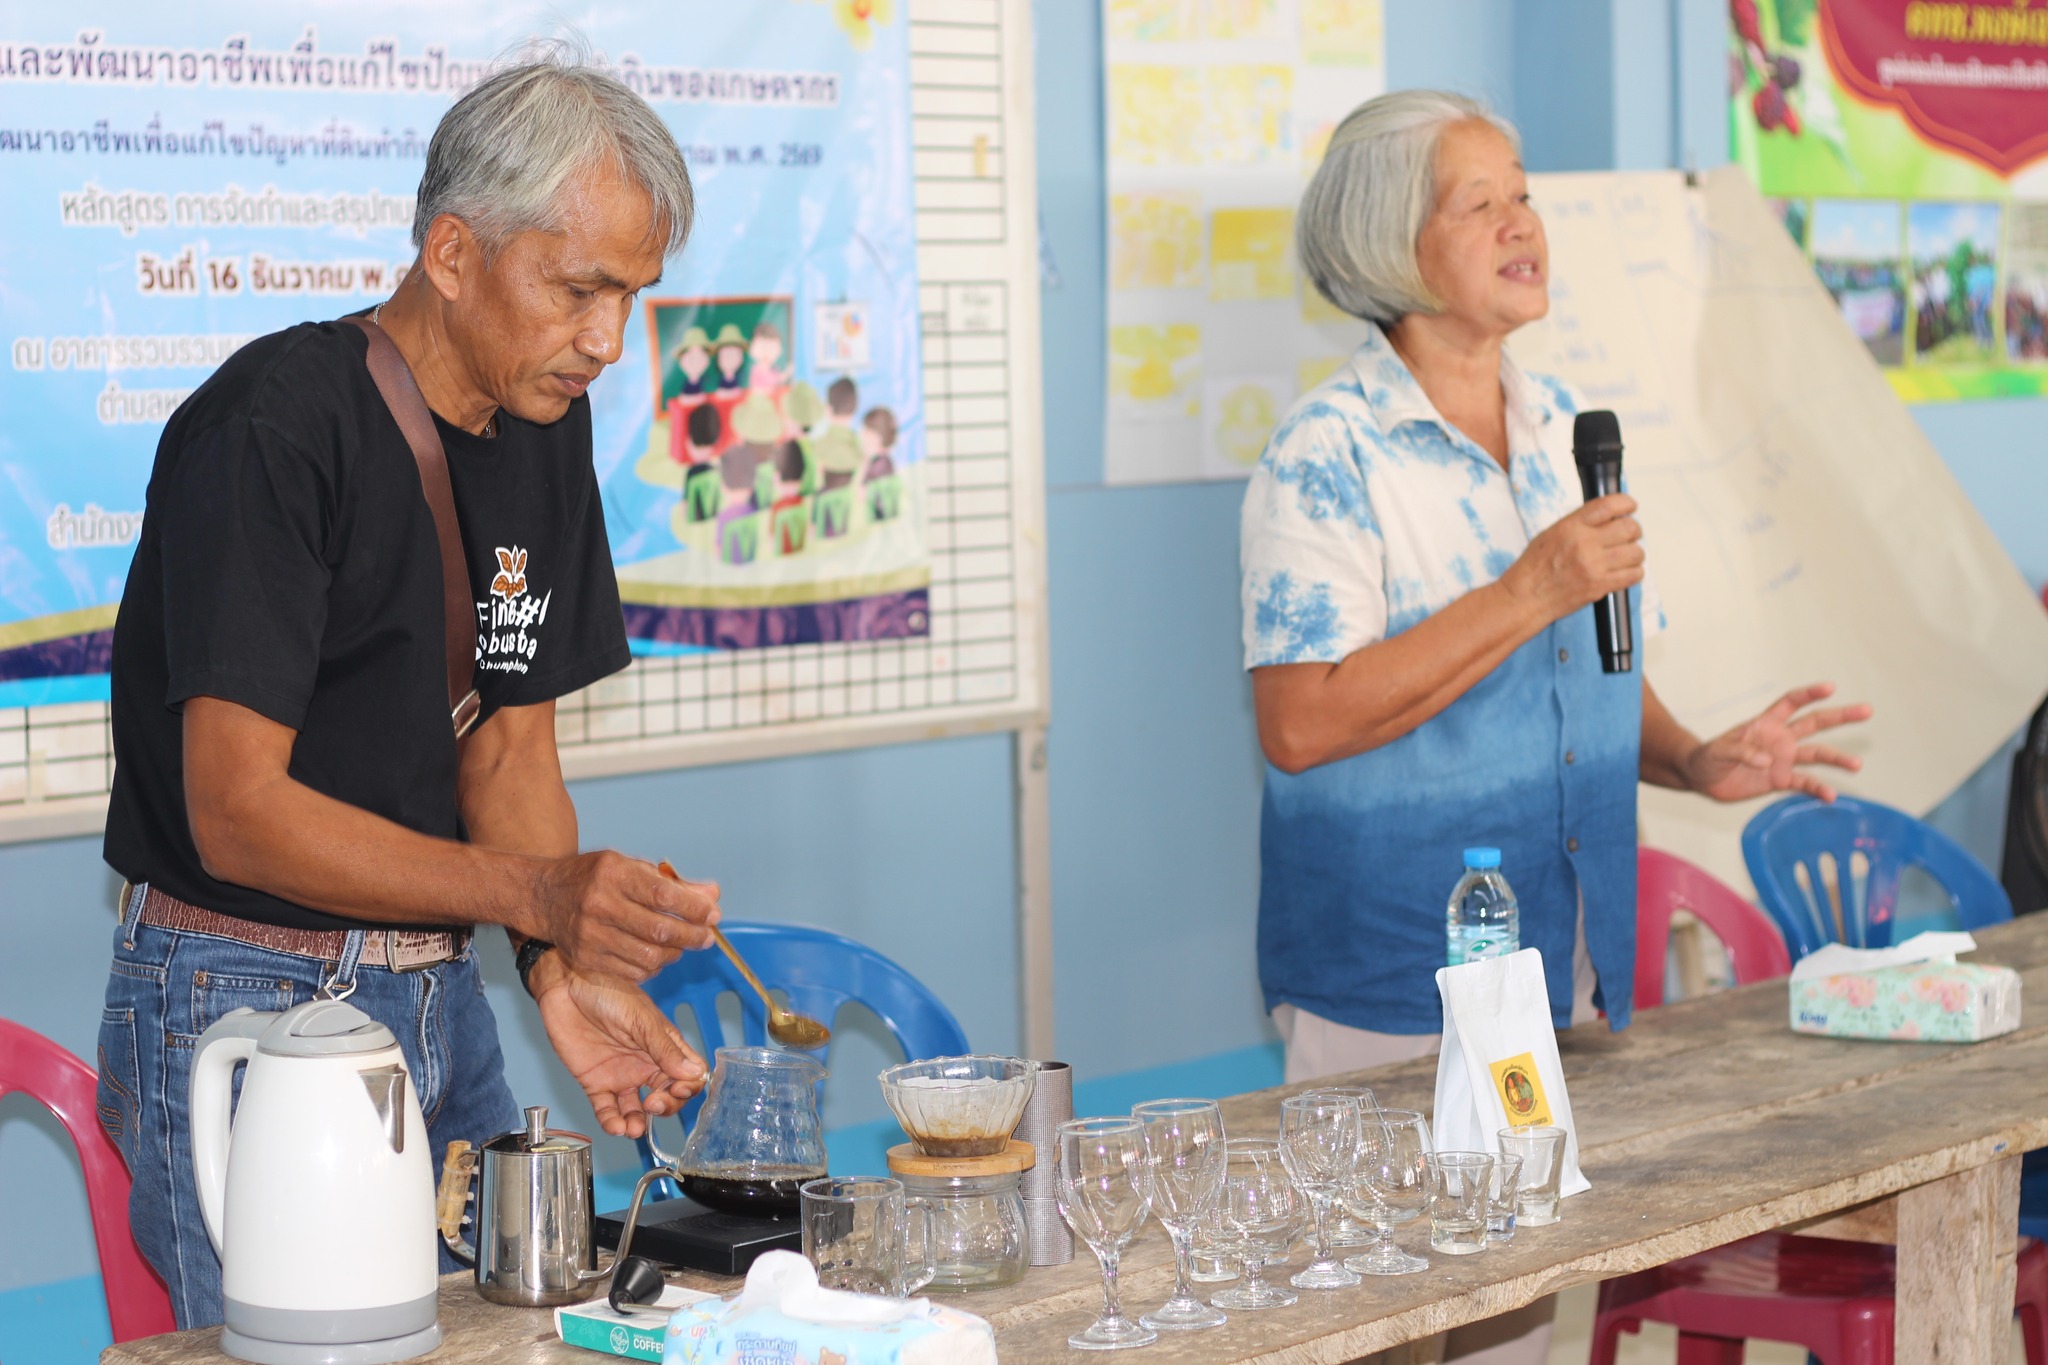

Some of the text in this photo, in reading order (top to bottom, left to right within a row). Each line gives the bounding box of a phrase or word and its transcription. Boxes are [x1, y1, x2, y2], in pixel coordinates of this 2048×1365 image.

[63, 188, 167, 233] หลักสูตร
[141, 252, 195, 291] วันที่
[208, 263, 238, 290] 16
[253, 258, 354, 291] ธันวาคม
[14, 338, 42, 368] ณ
[475, 628, 538, 660] obusta
